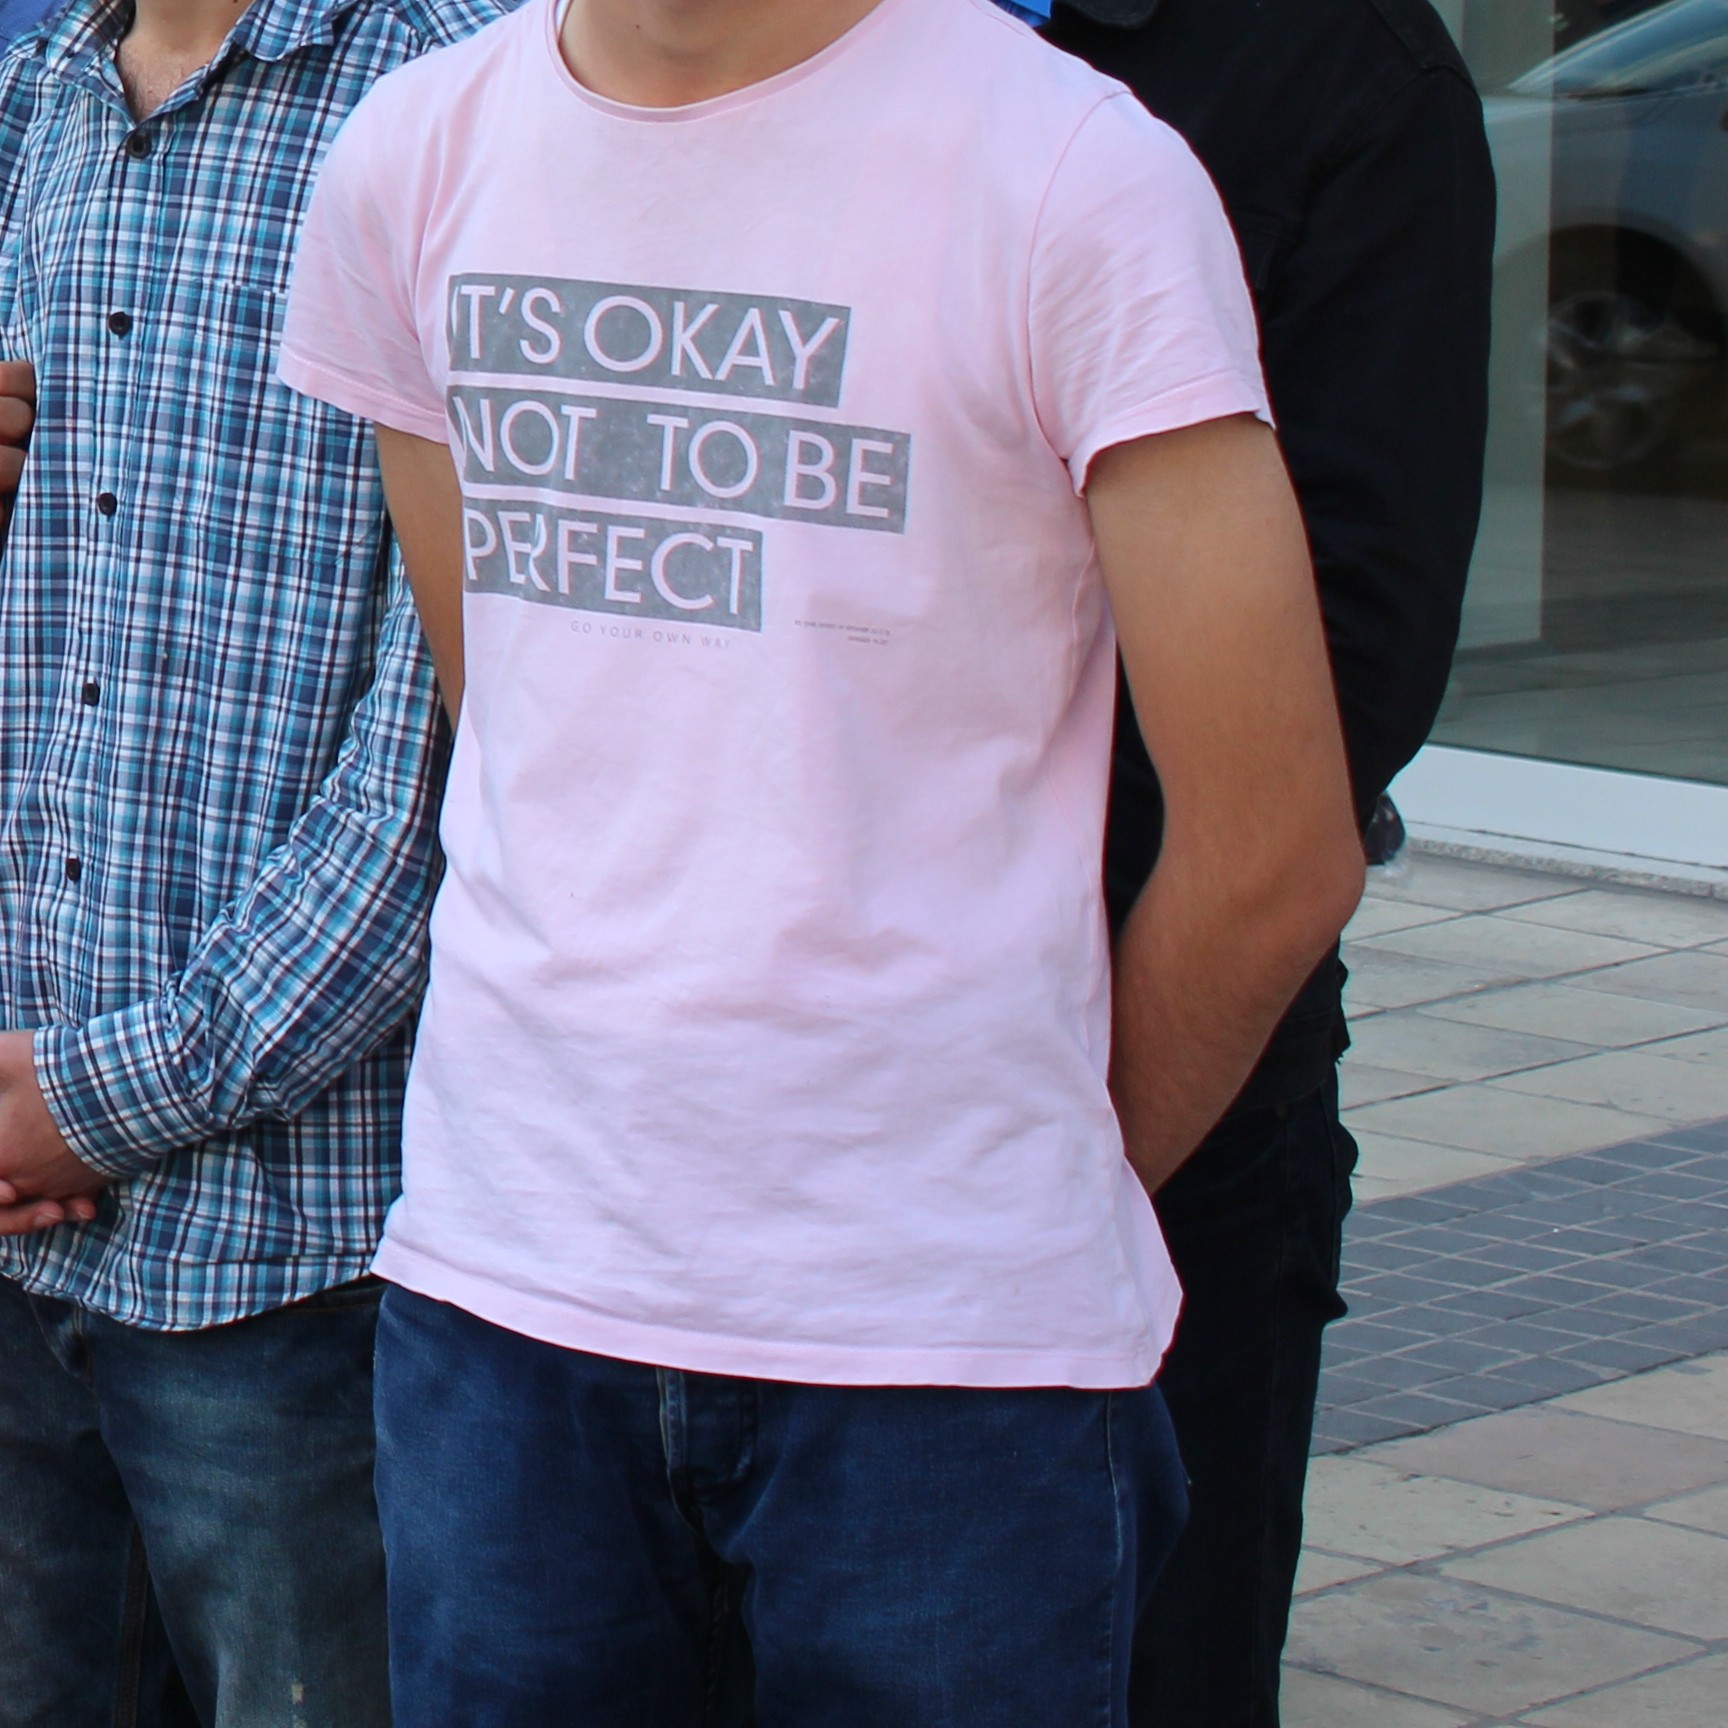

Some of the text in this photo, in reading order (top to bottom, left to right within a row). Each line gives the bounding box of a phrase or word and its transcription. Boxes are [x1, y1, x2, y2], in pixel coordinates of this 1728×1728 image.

[583, 294, 840, 390] OKAY
[452, 395, 895, 518] NOT TO BE
[571, 621, 732, 650] GO YOUR OWN WAY
